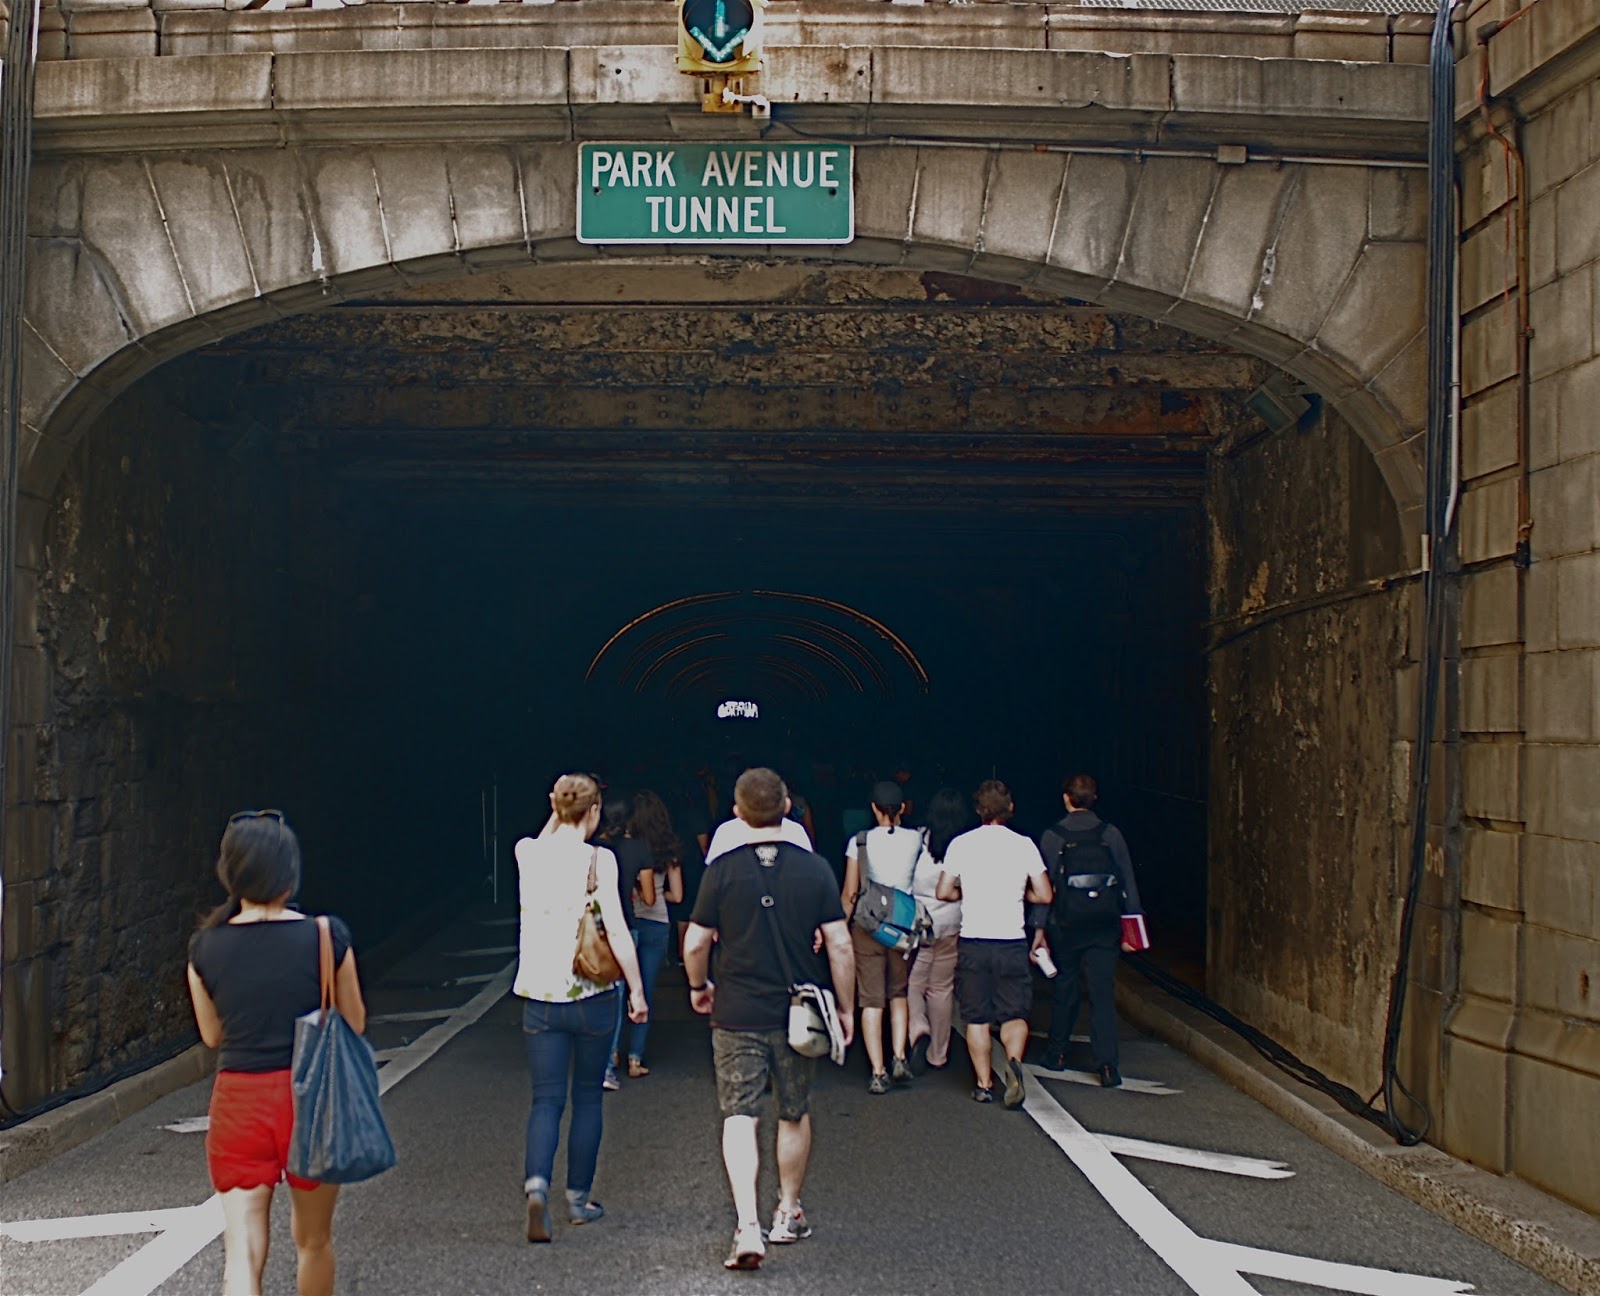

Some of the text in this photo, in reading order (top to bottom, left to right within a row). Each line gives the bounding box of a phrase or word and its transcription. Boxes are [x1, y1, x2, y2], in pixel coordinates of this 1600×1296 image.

[592, 151, 839, 188] PARK AVENUE
[645, 196, 786, 233] TUNNEL
